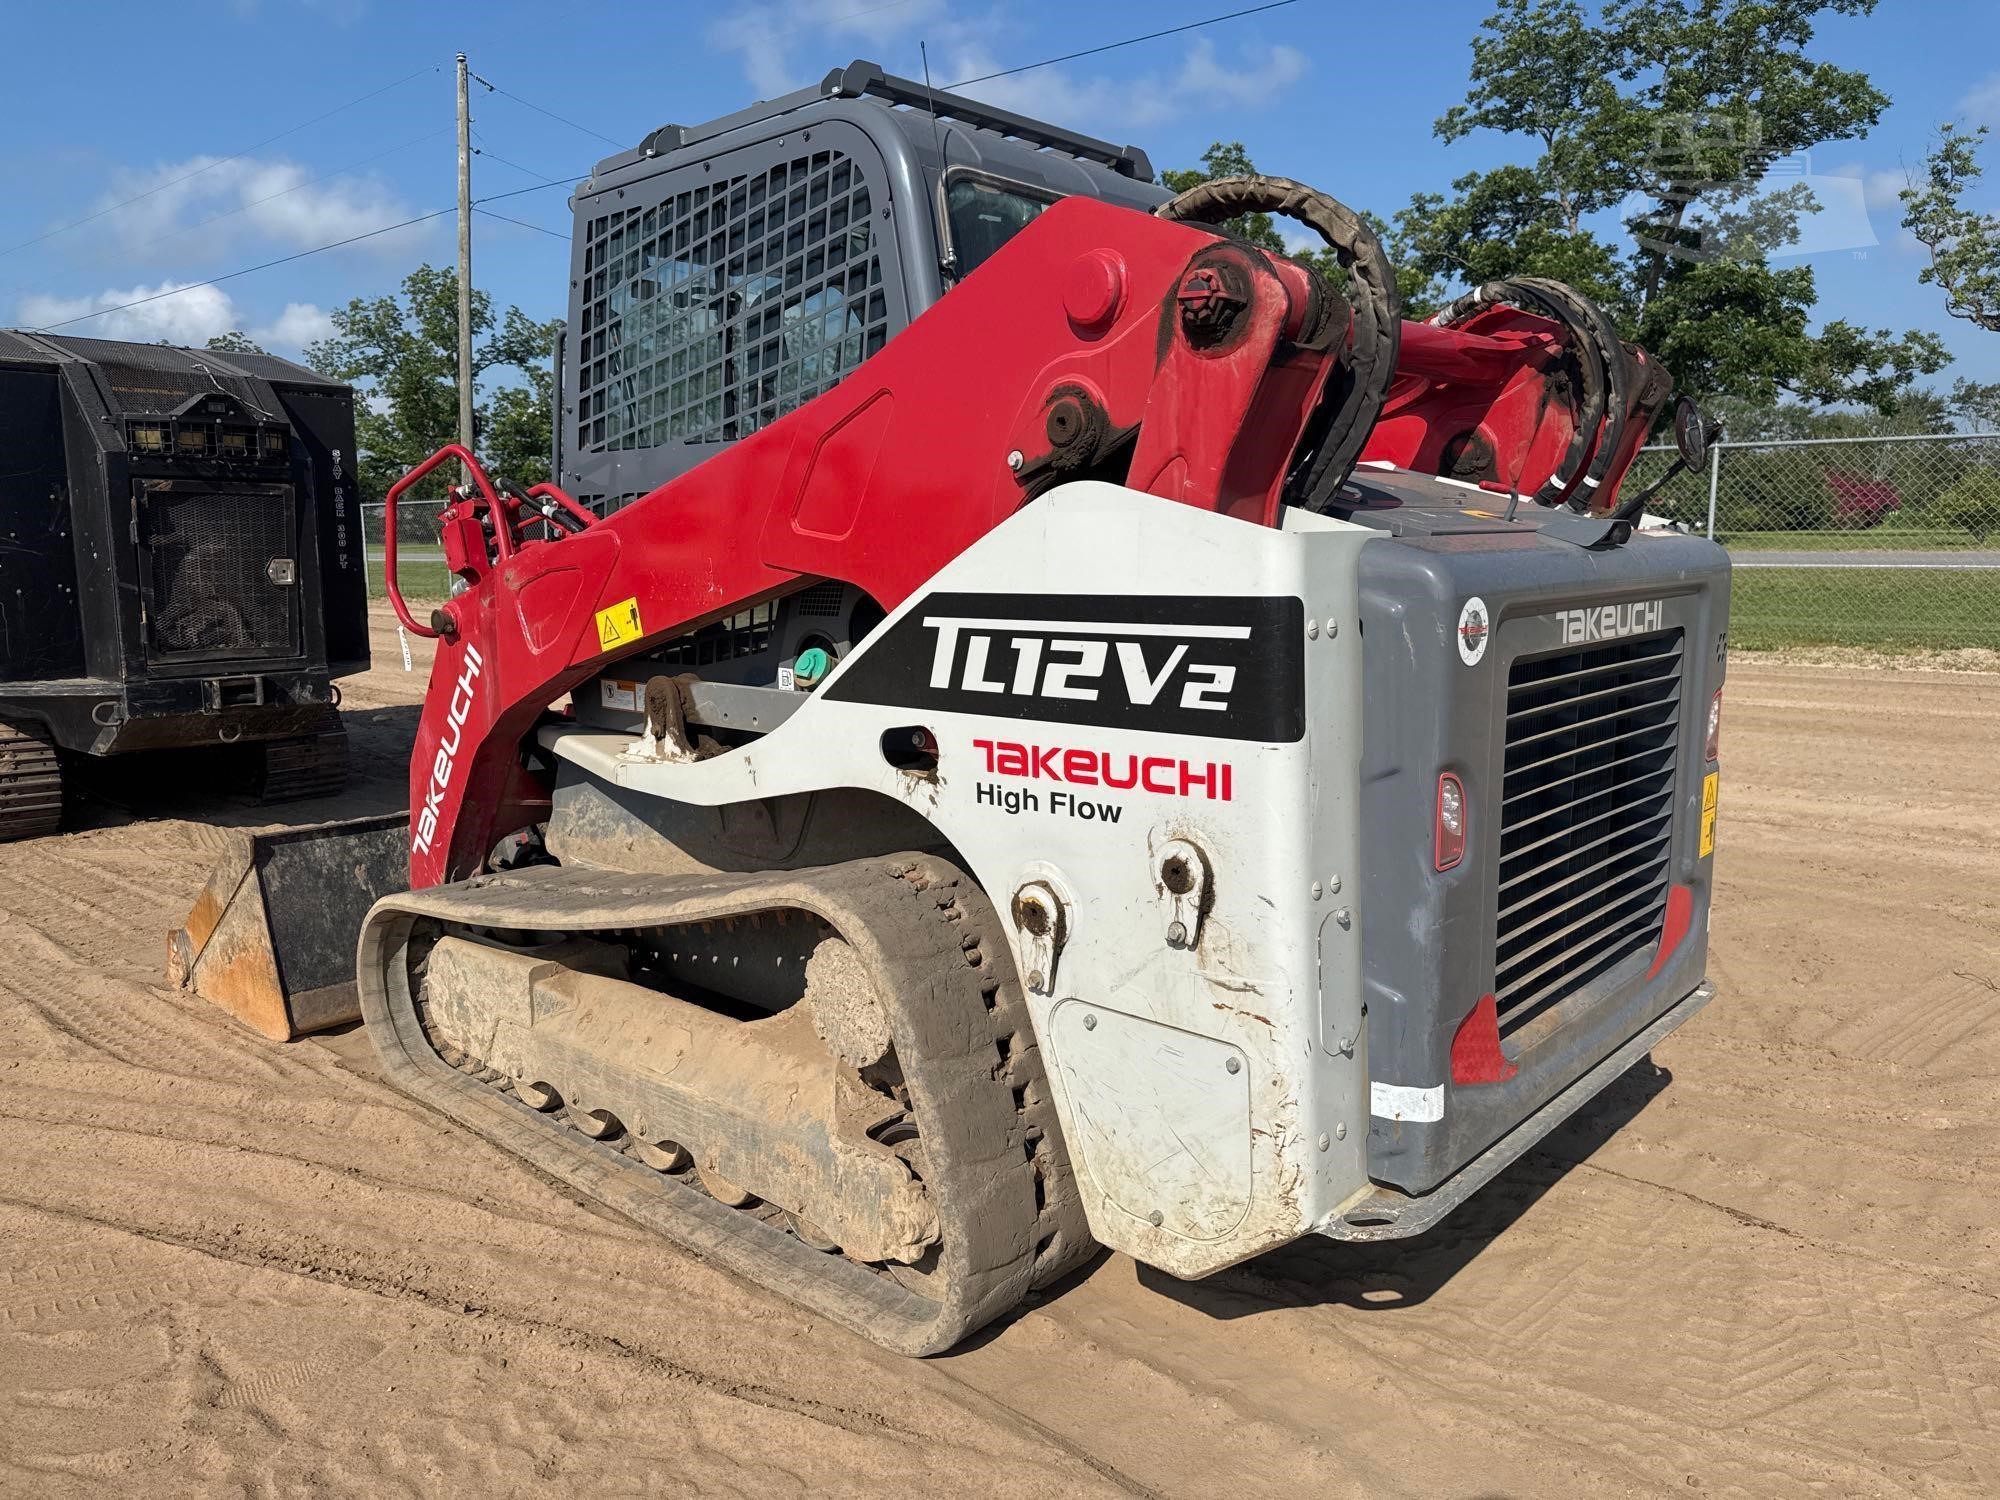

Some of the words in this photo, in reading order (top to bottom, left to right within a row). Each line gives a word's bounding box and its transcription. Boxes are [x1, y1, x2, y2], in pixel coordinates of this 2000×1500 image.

[331, 449, 343, 480] STAY
[334, 487, 345, 517] BACK
[339, 554, 349, 569] FT
[922, 616, 1252, 711] TL12V2
[976, 782, 1039, 815] High
[1051, 792, 1123, 823] Flow
